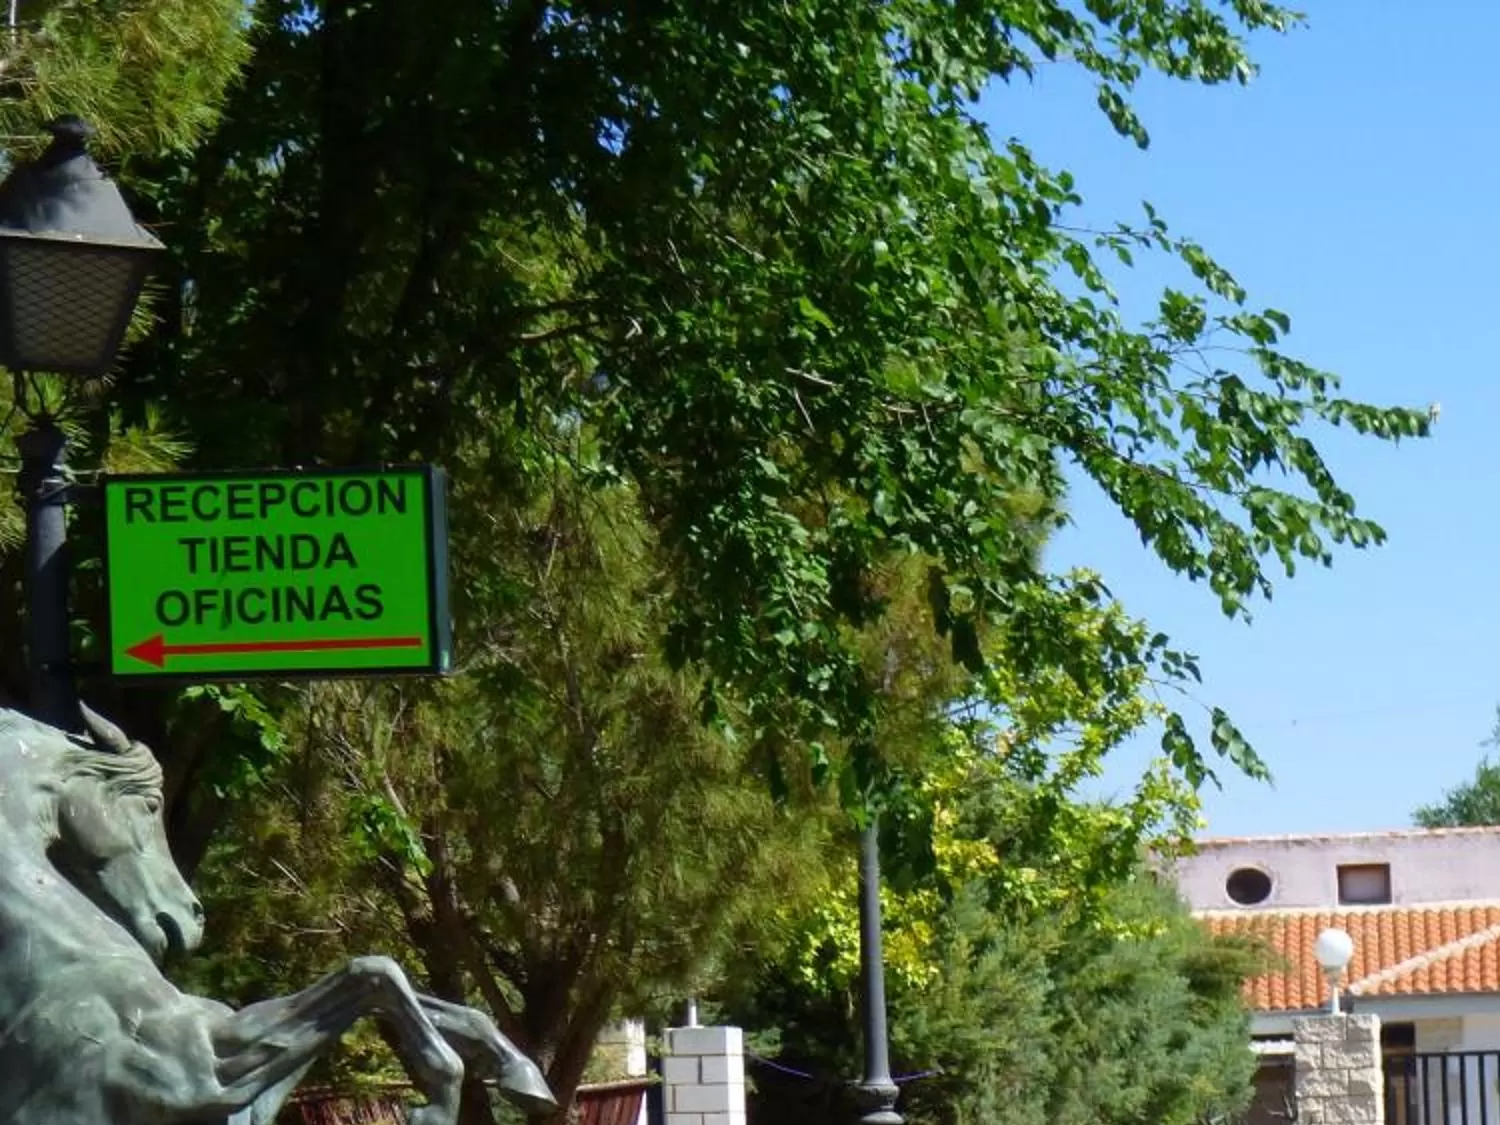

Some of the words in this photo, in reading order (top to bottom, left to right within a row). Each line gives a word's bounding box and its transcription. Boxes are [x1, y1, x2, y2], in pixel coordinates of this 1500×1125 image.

[124, 479, 407, 524] RECEPCION
[178, 532, 358, 574] TIENDA
[155, 583, 384, 627] OFICINAS
